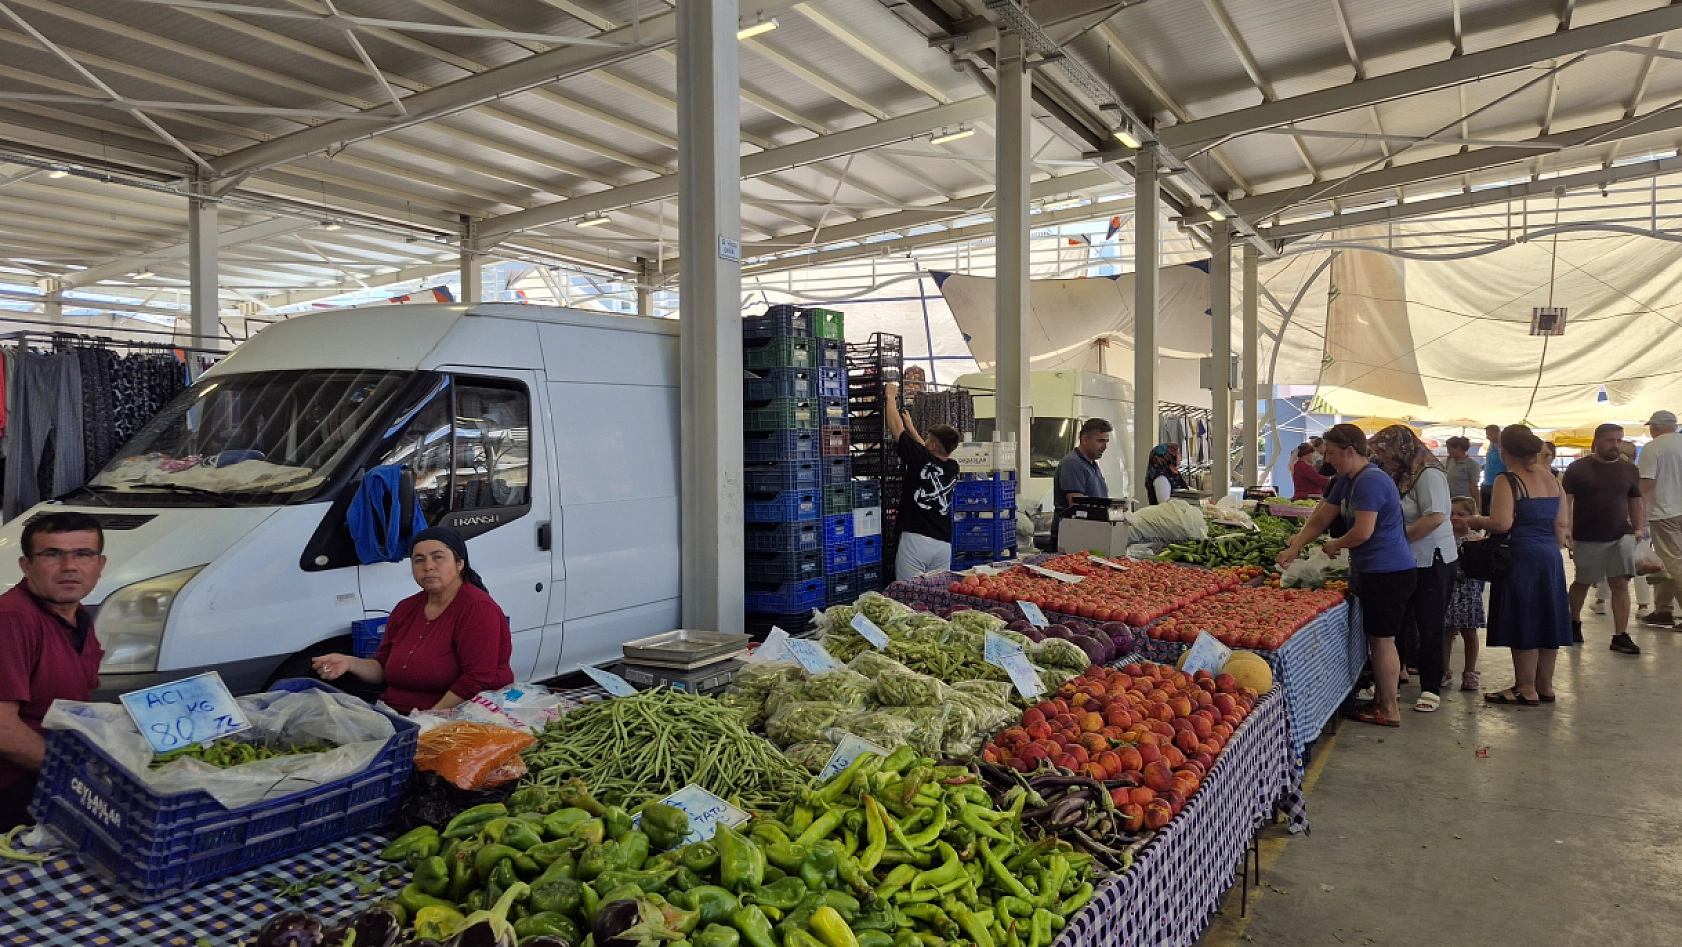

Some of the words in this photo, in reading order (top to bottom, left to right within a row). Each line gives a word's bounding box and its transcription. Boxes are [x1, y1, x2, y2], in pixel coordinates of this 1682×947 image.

[147, 690, 183, 708] ACI
[186, 701, 214, 714] KG
[151, 716, 195, 745] 80
